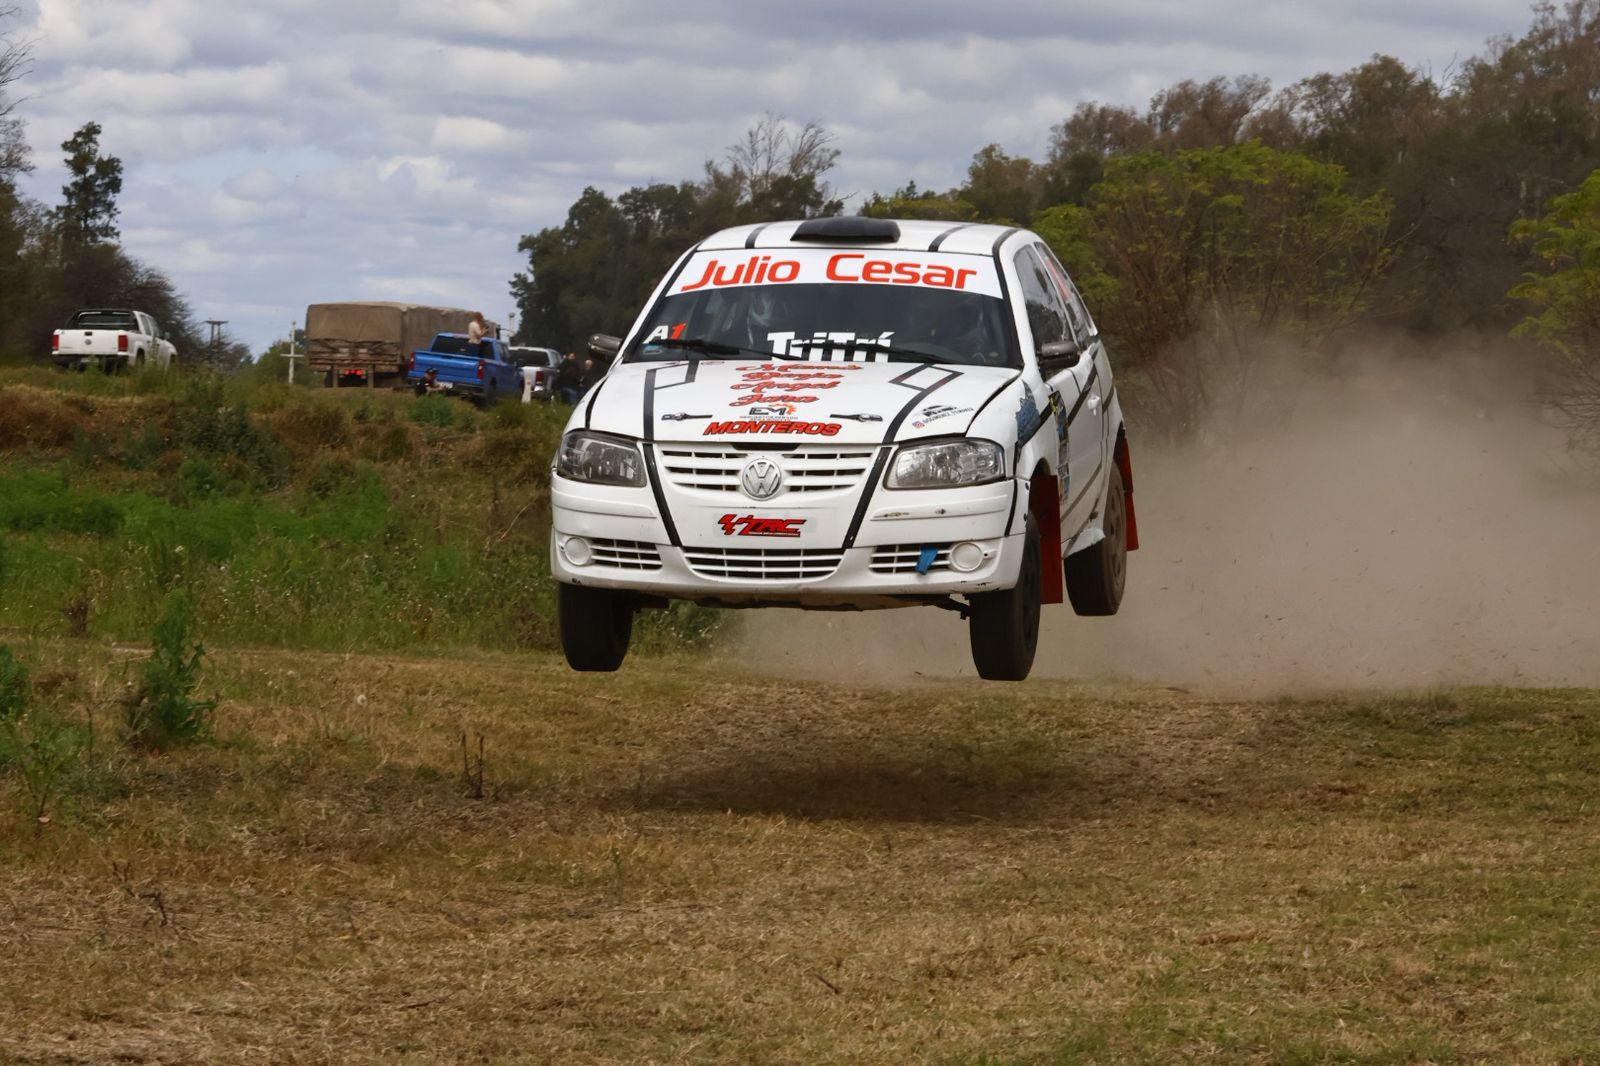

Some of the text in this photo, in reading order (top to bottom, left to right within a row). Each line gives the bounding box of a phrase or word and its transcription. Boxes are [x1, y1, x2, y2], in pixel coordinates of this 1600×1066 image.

[681, 254, 977, 292] Julio Cesar
[642, 322, 686, 344] A1
[703, 420, 842, 436] MONTEROS
